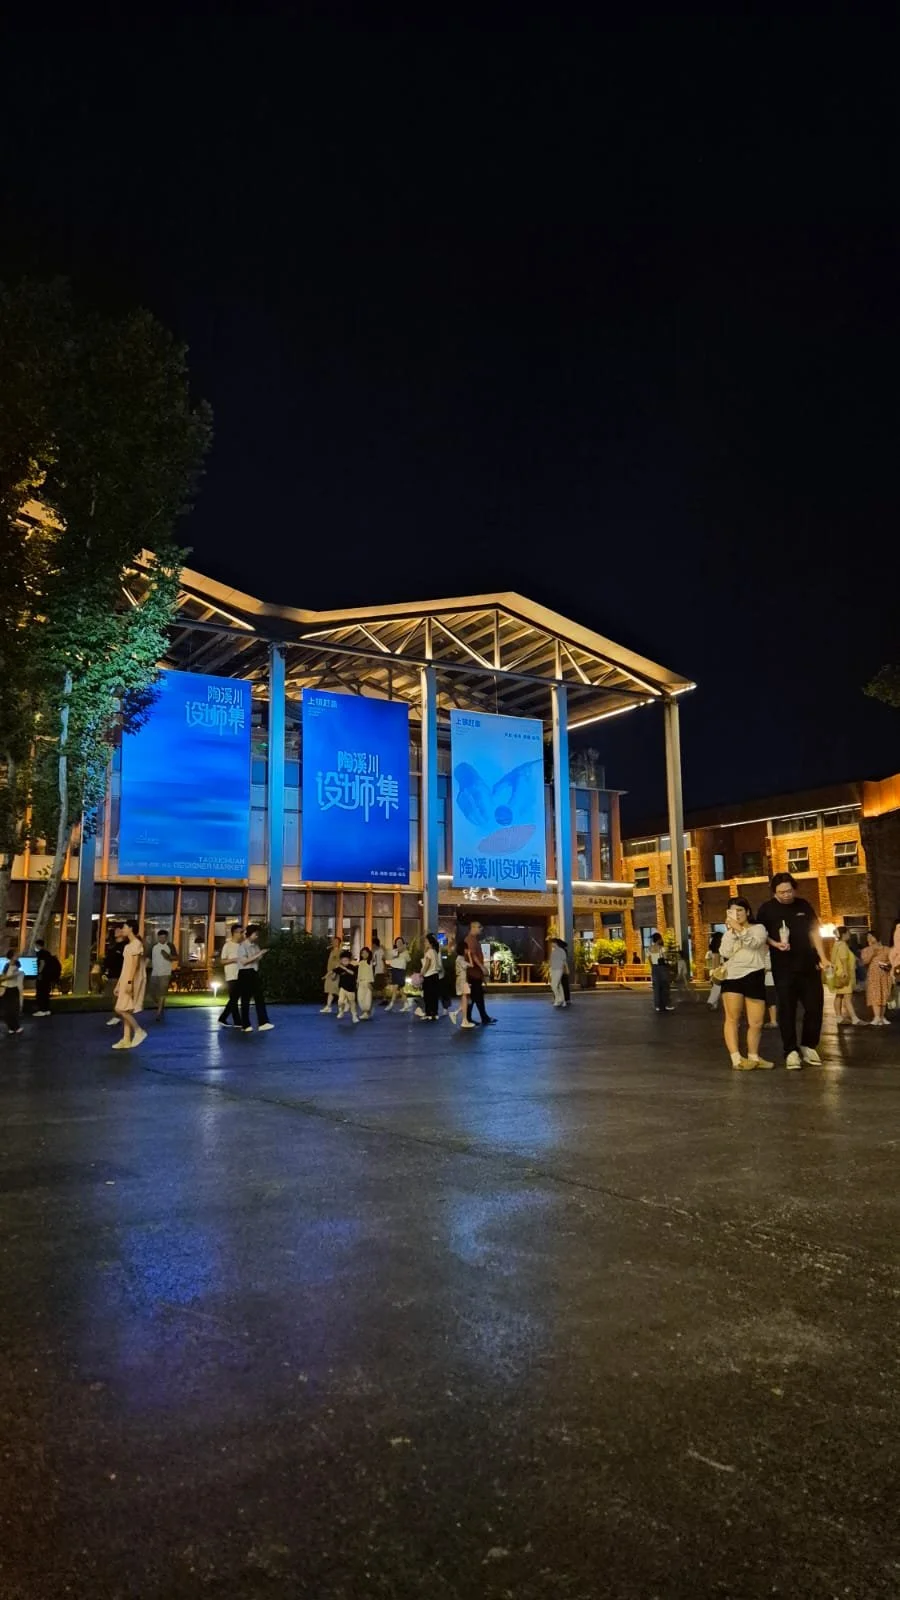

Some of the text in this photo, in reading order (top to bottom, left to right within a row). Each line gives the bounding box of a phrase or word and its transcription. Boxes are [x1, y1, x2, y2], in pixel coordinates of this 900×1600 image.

[207, 685, 243, 708] 陶溪川
[337, 750, 379, 779] 陶溪川
